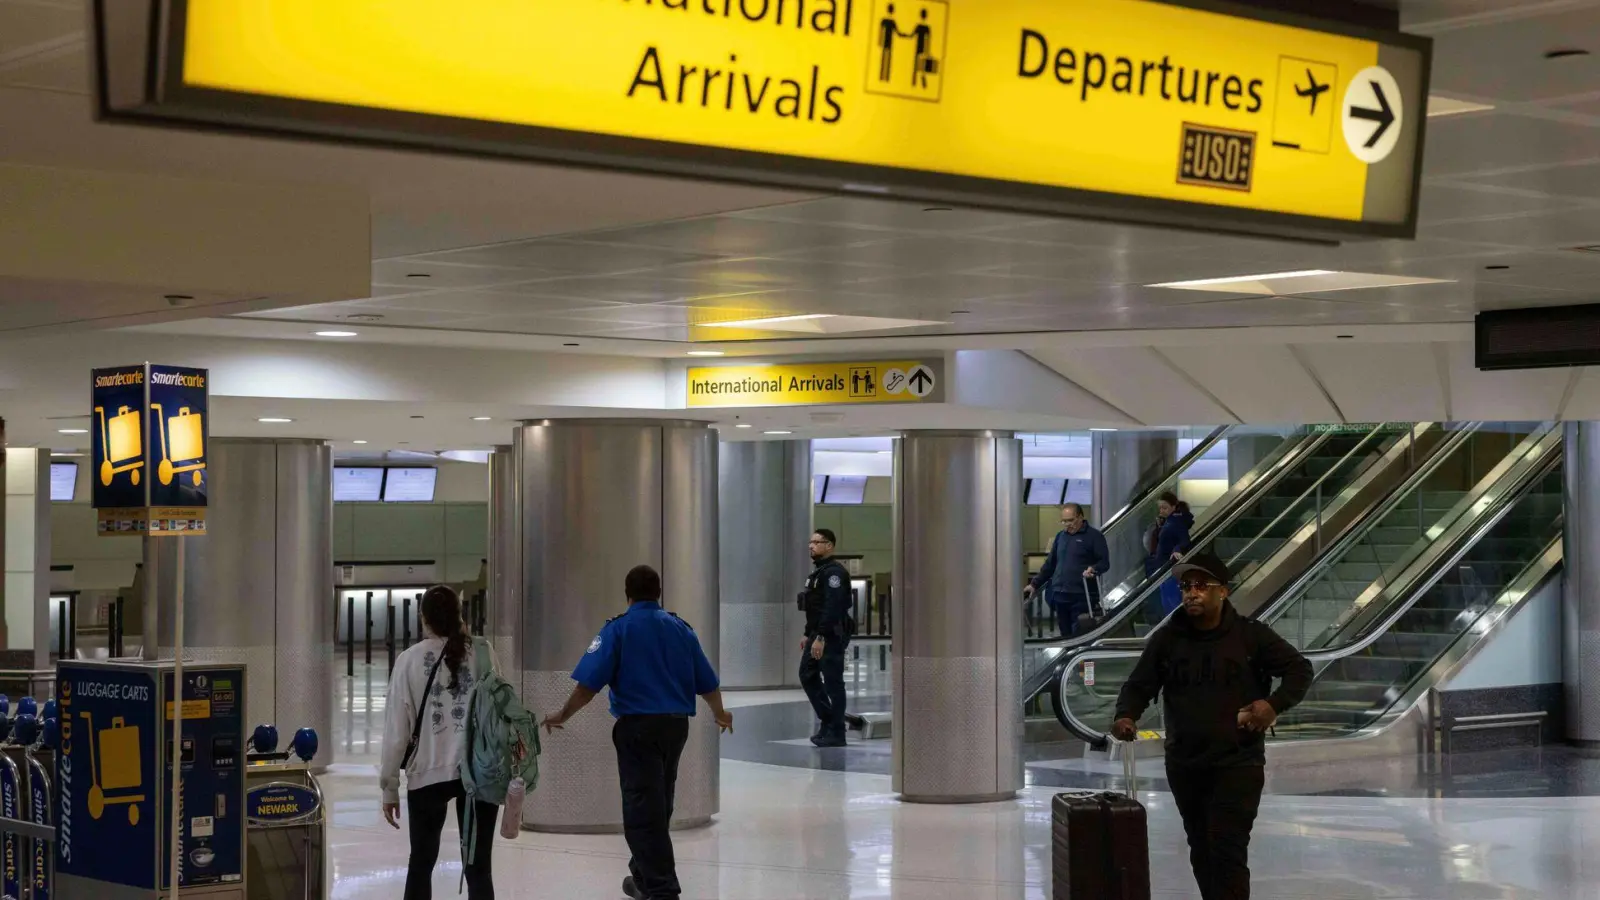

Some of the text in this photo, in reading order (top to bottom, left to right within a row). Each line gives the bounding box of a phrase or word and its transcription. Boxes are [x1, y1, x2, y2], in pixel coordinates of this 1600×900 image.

[625, 46, 845, 124] Arrivals
[1017, 27, 1264, 113] Departures
[1193, 132, 1241, 181] USO
[691, 373, 845, 395] International Arrivals
[77, 681, 149, 701] LUGGAGE CARTS
[4, 782, 15, 881] smaecarte
[33, 787, 45, 890] smaecarte
[257, 803, 299, 815] NEWARK
